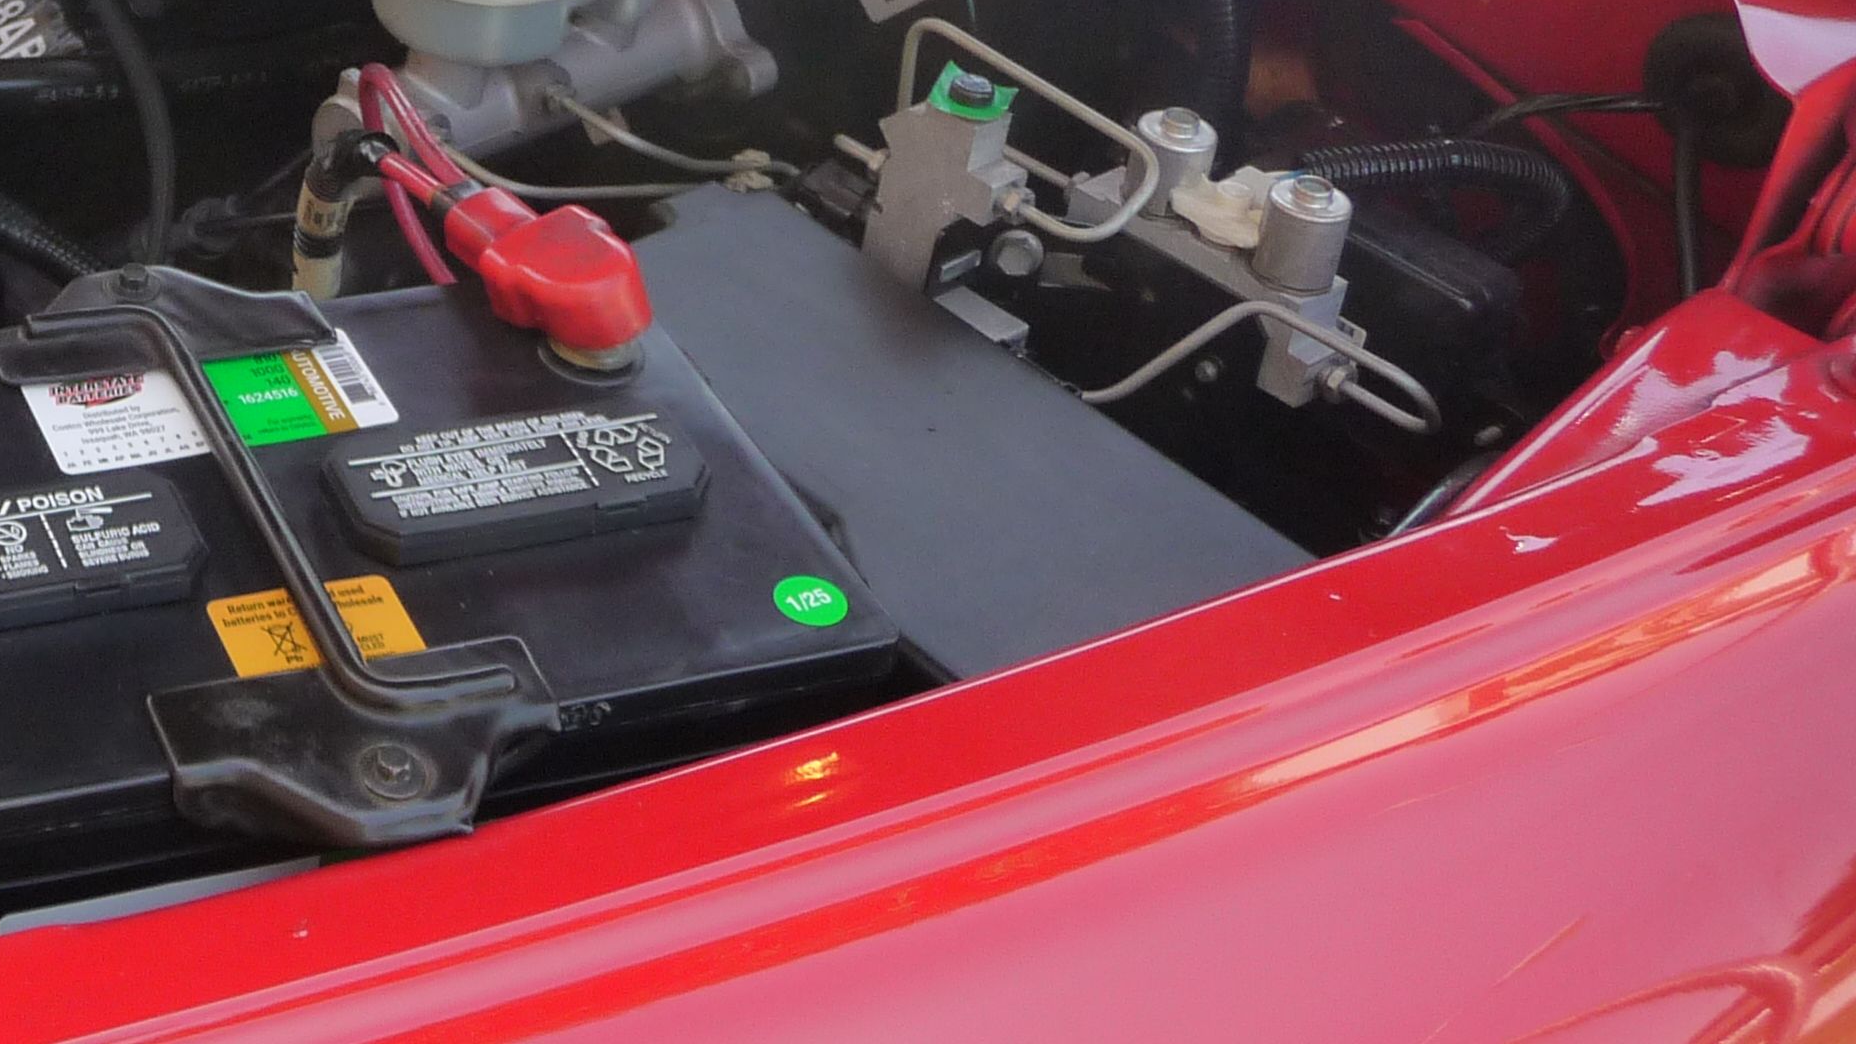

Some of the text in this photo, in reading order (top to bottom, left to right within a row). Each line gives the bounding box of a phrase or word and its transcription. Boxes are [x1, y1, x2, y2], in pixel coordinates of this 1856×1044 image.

[49, 373, 144, 397] INTERSTATE
[56, 385, 142, 405] BATTERIES
[291, 347, 346, 421] UTOMOTIVE
[238, 387, 298, 406] 1624516
[82, 407, 128, 420] Distributed
[84, 415, 127, 428] Wholesale
[473, 437, 548, 459] IMMEDIATELY
[16, 486, 104, 512] POISON
[71, 521, 160, 544] SULFURIC ACID
[5, 545, 24, 555] NO
[130, 540, 146, 550] OR
[227, 599, 265, 614] Return
[338, 584, 364, 596] used
[784, 587, 832, 613] 1/25
[222, 612, 272, 628] batteries
[274, 609, 286, 619] to
[336, 596, 384, 609] holesale
